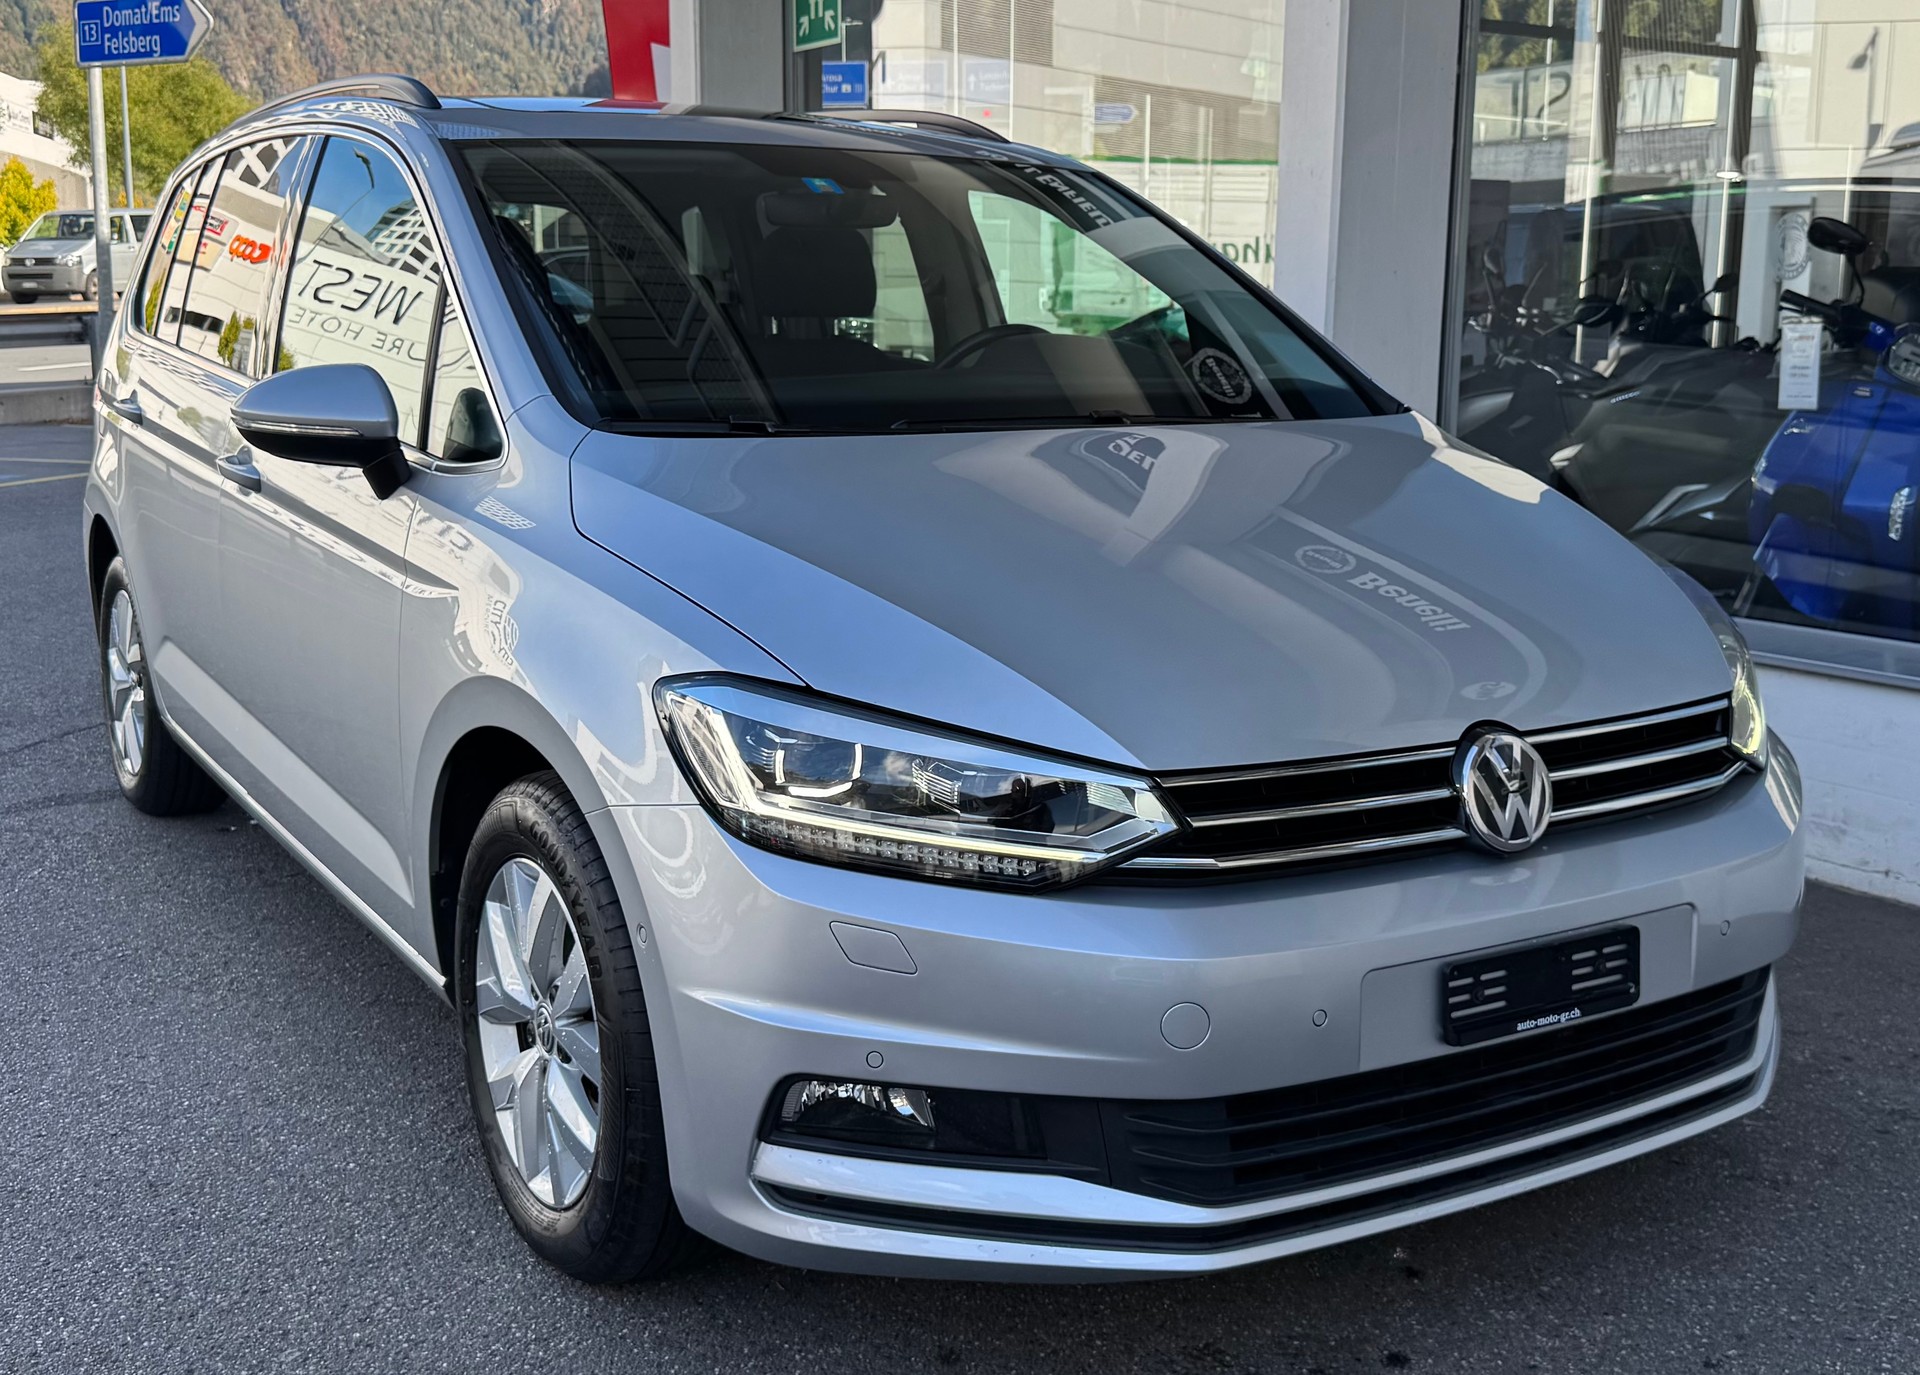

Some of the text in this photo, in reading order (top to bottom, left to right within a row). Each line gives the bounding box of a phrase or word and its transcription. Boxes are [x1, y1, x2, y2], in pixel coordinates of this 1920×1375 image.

[103, 1, 181, 28] Domat/Ems
[83, 24, 97, 42] 13
[104, 31, 161, 57] Felsberg
[1516, 1007, 1582, 1031] auto-moto-gr.ch
